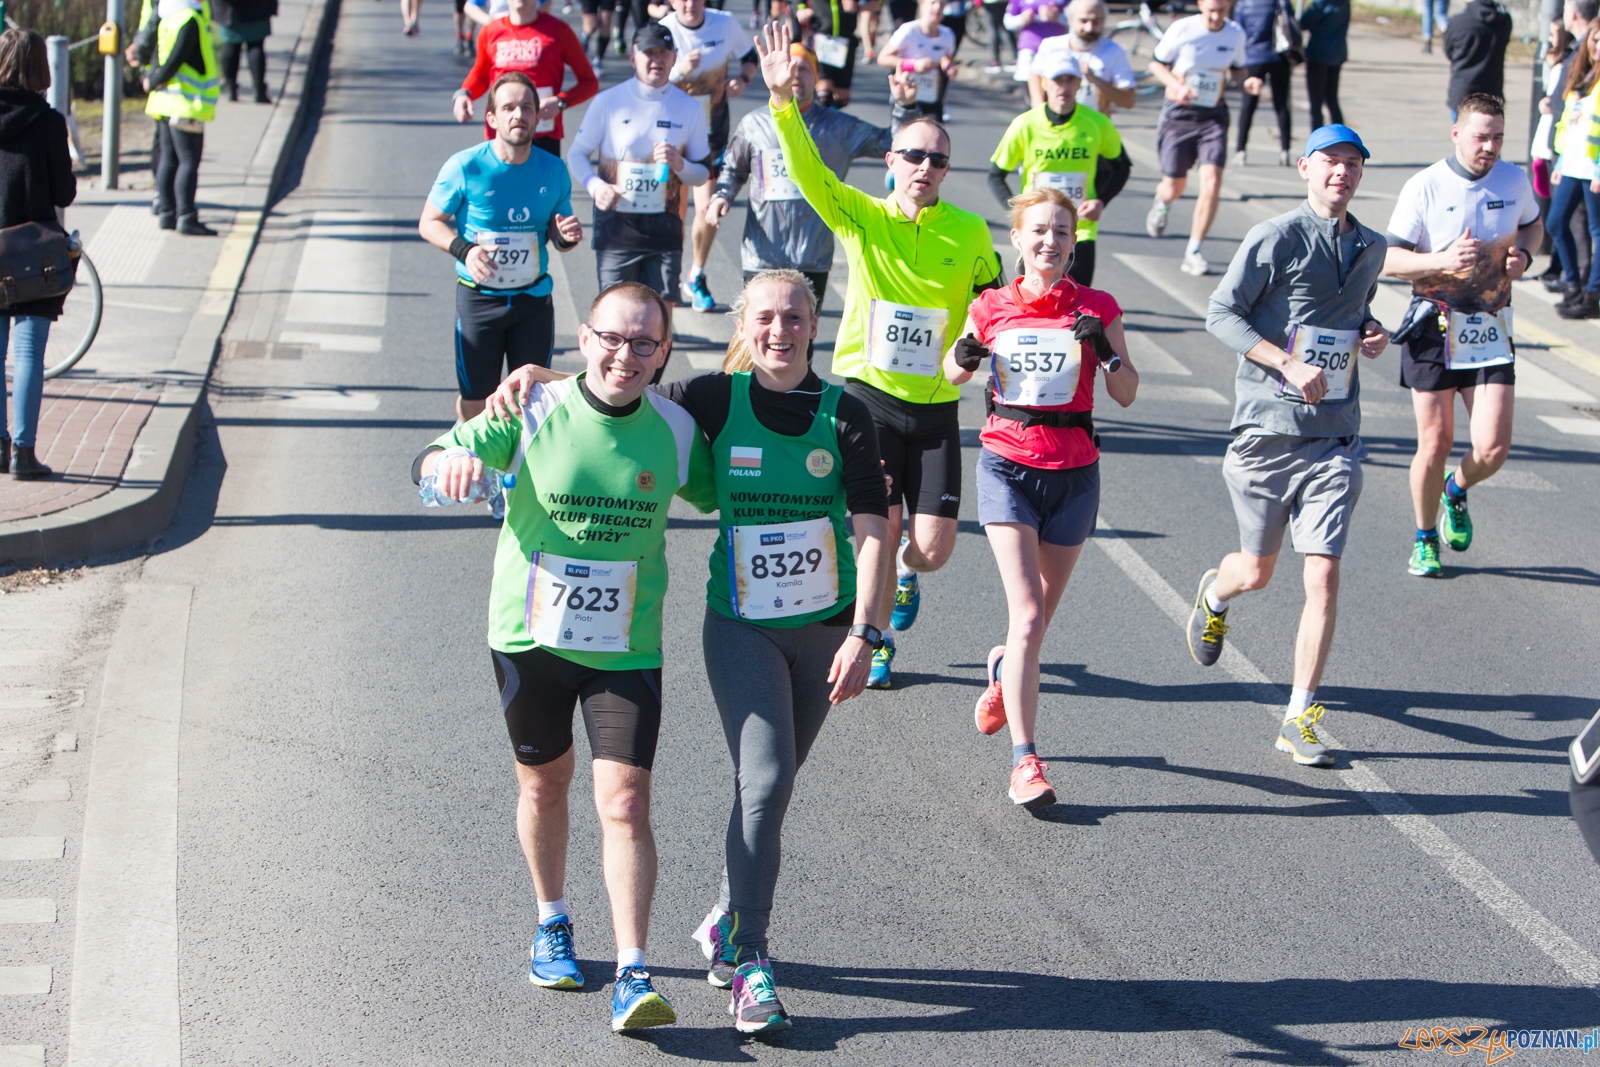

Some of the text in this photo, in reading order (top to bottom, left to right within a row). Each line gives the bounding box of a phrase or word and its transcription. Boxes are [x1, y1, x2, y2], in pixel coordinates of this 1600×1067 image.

[1036, 147, 1090, 159] PAWEŁ
[625, 178, 659, 192] 8219
[885, 324, 932, 347] 8141
[1458, 326, 1499, 345] 6268
[1009, 352, 1067, 373] 5537
[1303, 348, 1350, 371] 2508
[728, 468, 762, 477] POLAND
[548, 493, 658, 513] NOWOTOMYSKI
[730, 492, 835, 506] NOWOTOMYSKI
[549, 510, 653, 529] KLUB BIEGACZA
[733, 507, 765, 518] KLUB
[751, 548, 822, 580] 8329
[776, 579, 803, 588] Kamila
[552, 582, 620, 613] 7623
[574, 613, 594, 622] Piotr
